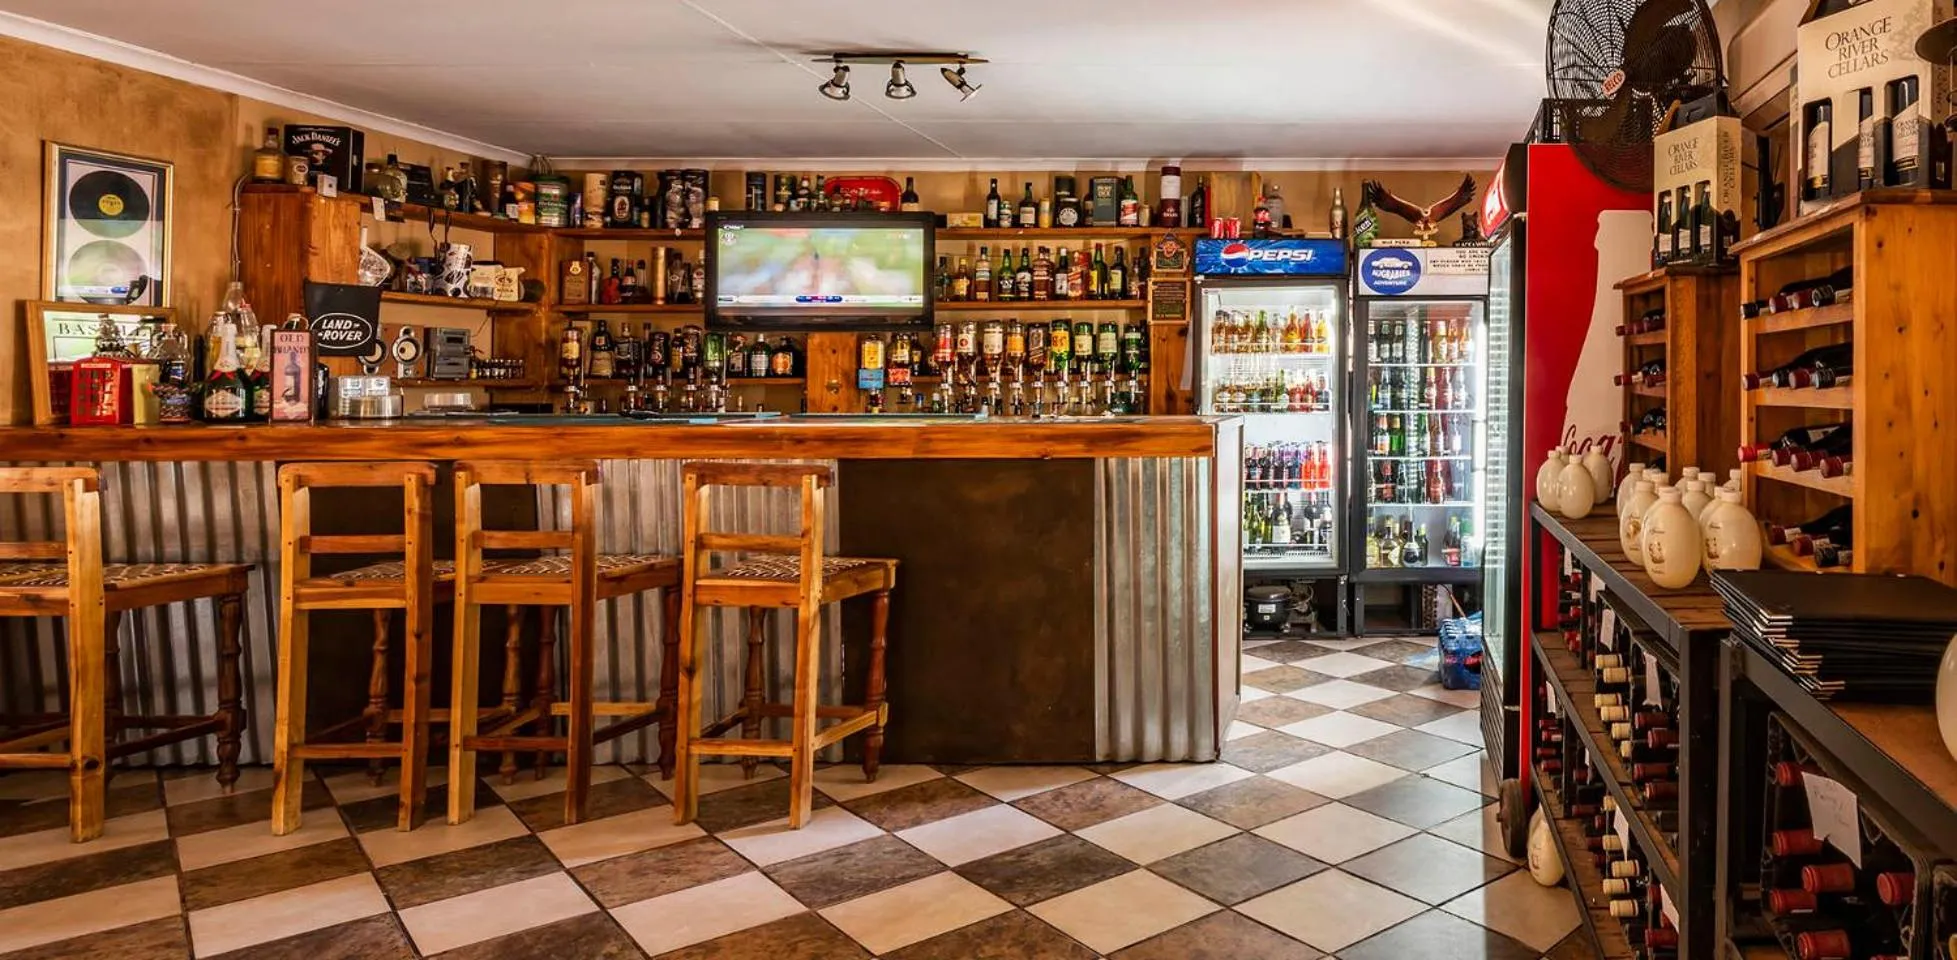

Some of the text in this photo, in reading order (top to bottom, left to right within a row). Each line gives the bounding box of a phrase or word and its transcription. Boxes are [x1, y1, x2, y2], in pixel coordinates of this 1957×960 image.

[1825, 16, 1893, 51] ORANGE
[1838, 38, 1880, 62] RIVER
[1827, 50, 1889, 79] CELLARS
[1668, 136, 1699, 156] ORANGE
[1674, 151, 1694, 164] RIVER
[1669, 161, 1698, 176] CELLARS
[1248, 249, 1314, 261] PEPSI
[321, 319, 353, 330] LAND
[279, 333, 304, 343] OLD
[322, 330, 363, 341] ROVER
